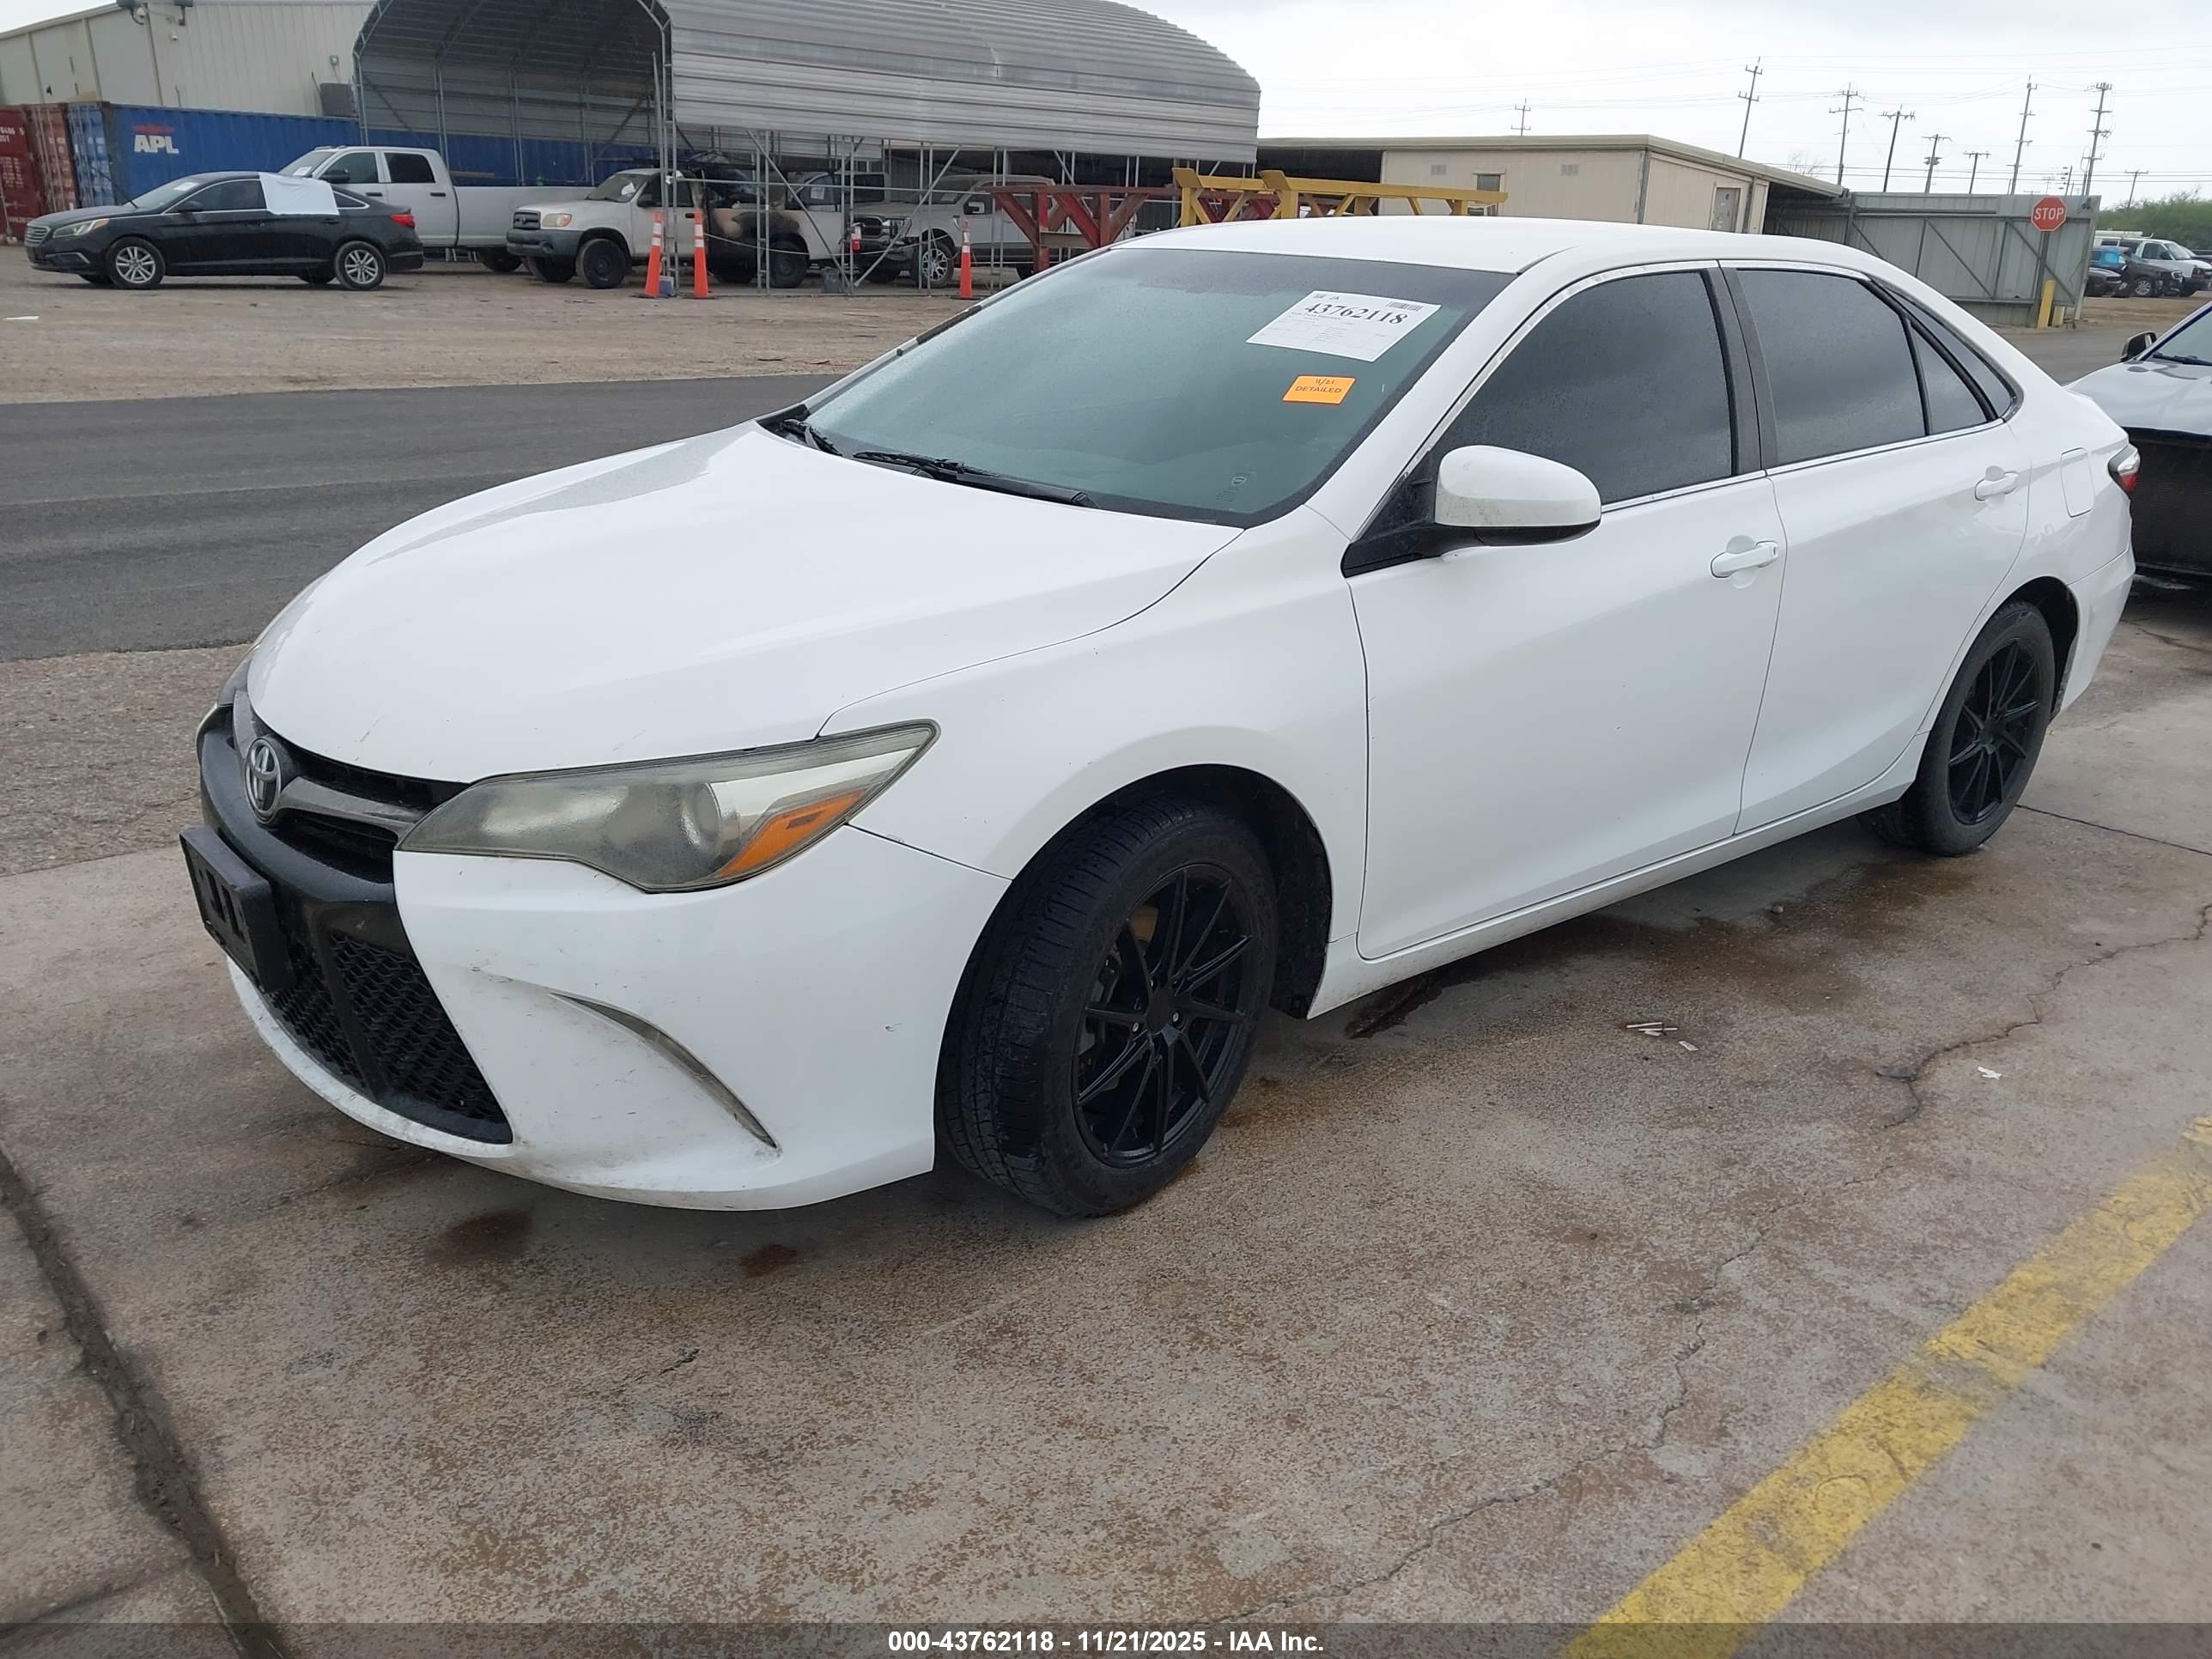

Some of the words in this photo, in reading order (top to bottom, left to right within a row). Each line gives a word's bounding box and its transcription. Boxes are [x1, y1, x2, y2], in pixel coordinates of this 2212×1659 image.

[134, 134, 179, 155] APL
[2033, 207, 2064, 221] STOP
[1304, 302, 1408, 325] 43762118
